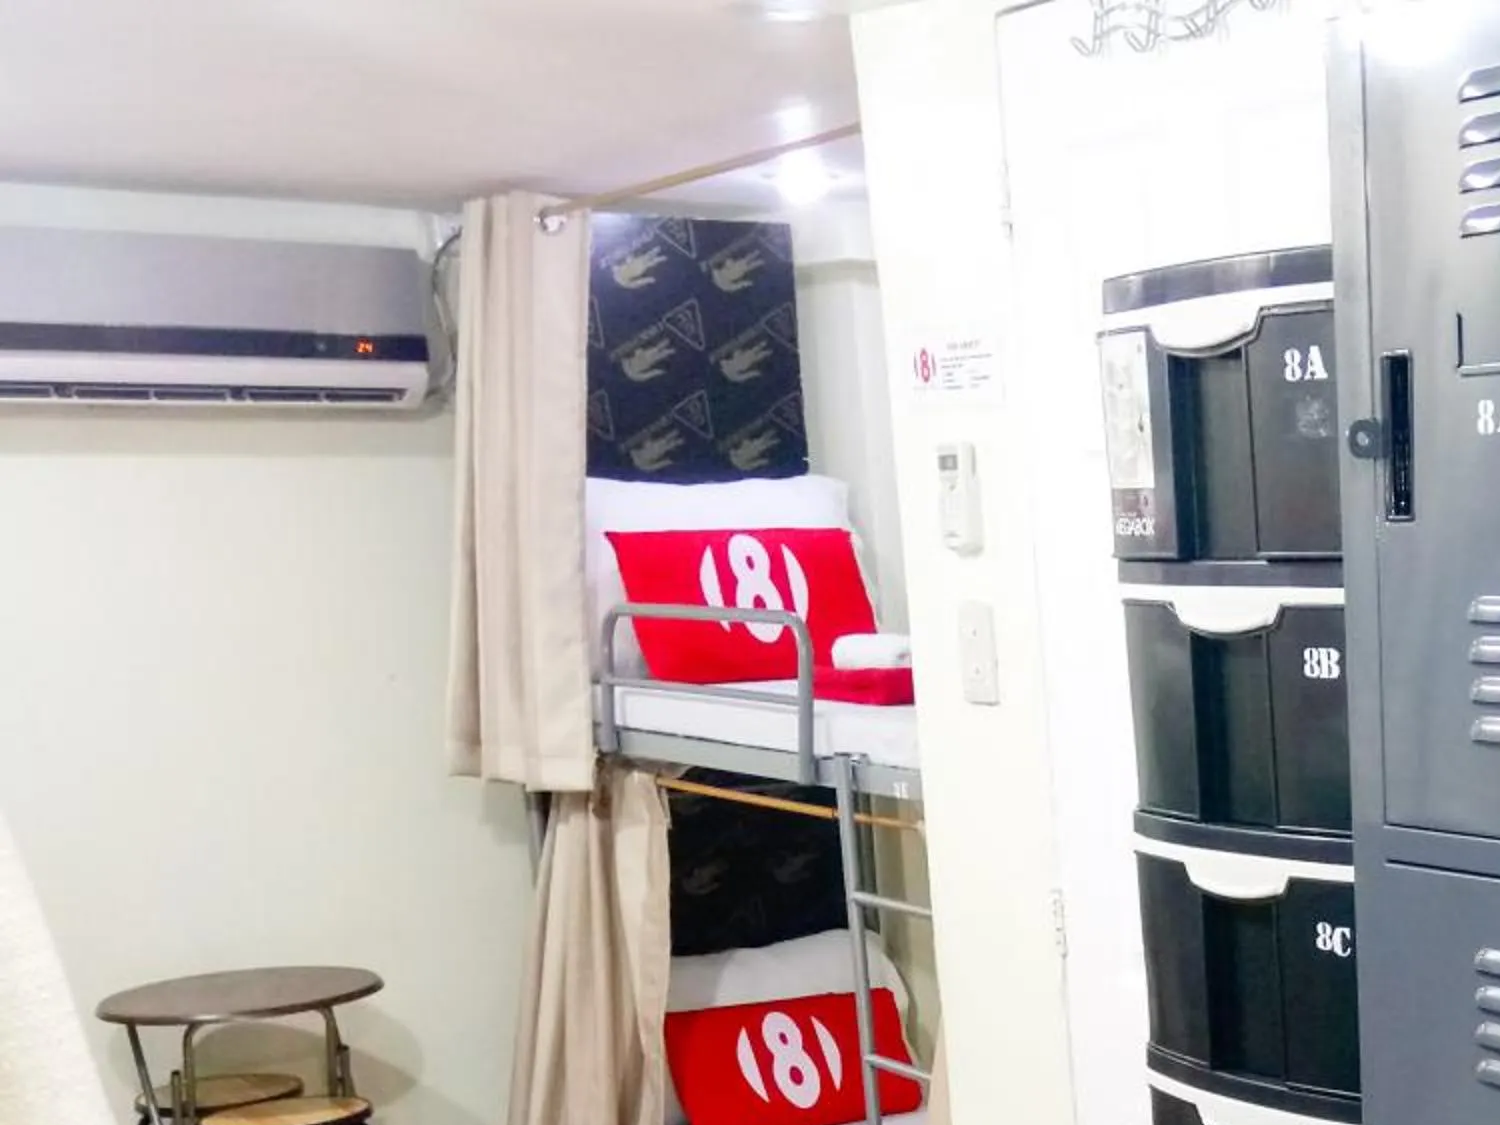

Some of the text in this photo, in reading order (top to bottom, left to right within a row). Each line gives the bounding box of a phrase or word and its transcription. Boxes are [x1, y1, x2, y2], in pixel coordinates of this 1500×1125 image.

[1283, 345, 1329, 382] 8A
[1303, 647, 1341, 679] 8B
[1315, 921, 1351, 957] 8C
